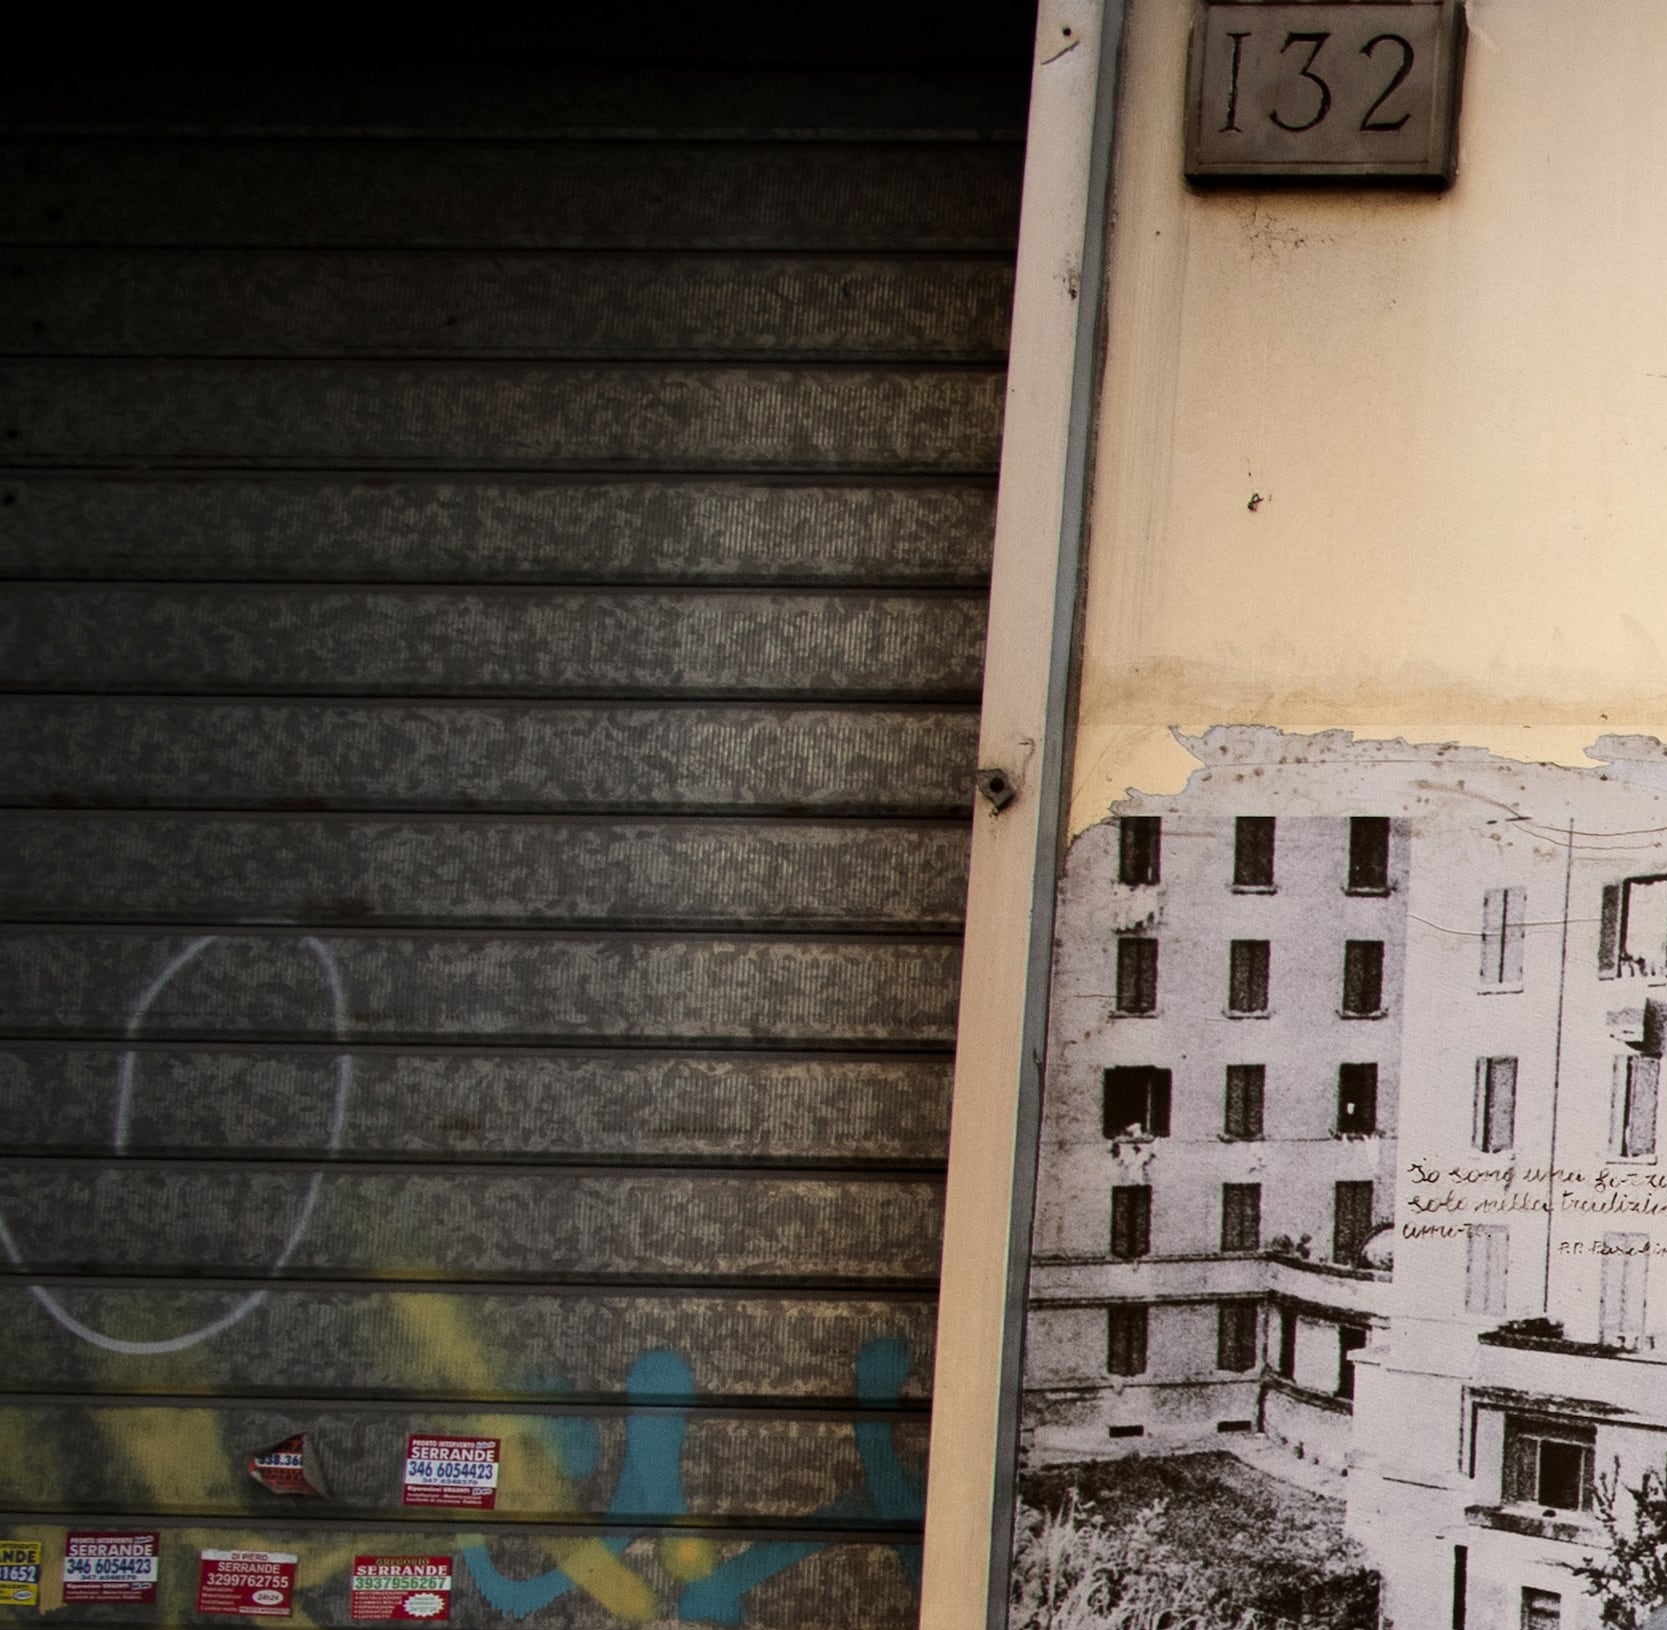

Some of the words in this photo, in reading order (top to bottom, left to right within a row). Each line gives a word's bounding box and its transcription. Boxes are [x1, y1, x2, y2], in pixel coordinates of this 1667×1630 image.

[1219, 32, 1413, 133] 132
[1449, 1166, 1516, 1184] sono
[1522, 1167, 1585, 1184] una
[411, 1447, 495, 1462] SERRANDE
[409, 1461, 433, 1477] 346
[437, 1462, 493, 1480] 6054423
[0, 1550, 35, 1563] NDE
[69, 1545, 153, 1556] SERRANDE
[0, 1564, 35, 1583] 1652
[67, 1558, 91, 1573] 346
[95, 1559, 151, 1574] 6054423
[218, 1562, 280, 1574] SERRANDE
[357, 1565, 448, 1576] SERRANDE
[207, 1573, 289, 1588] 3299762755
[355, 1577, 446, 1589] 3937956267
